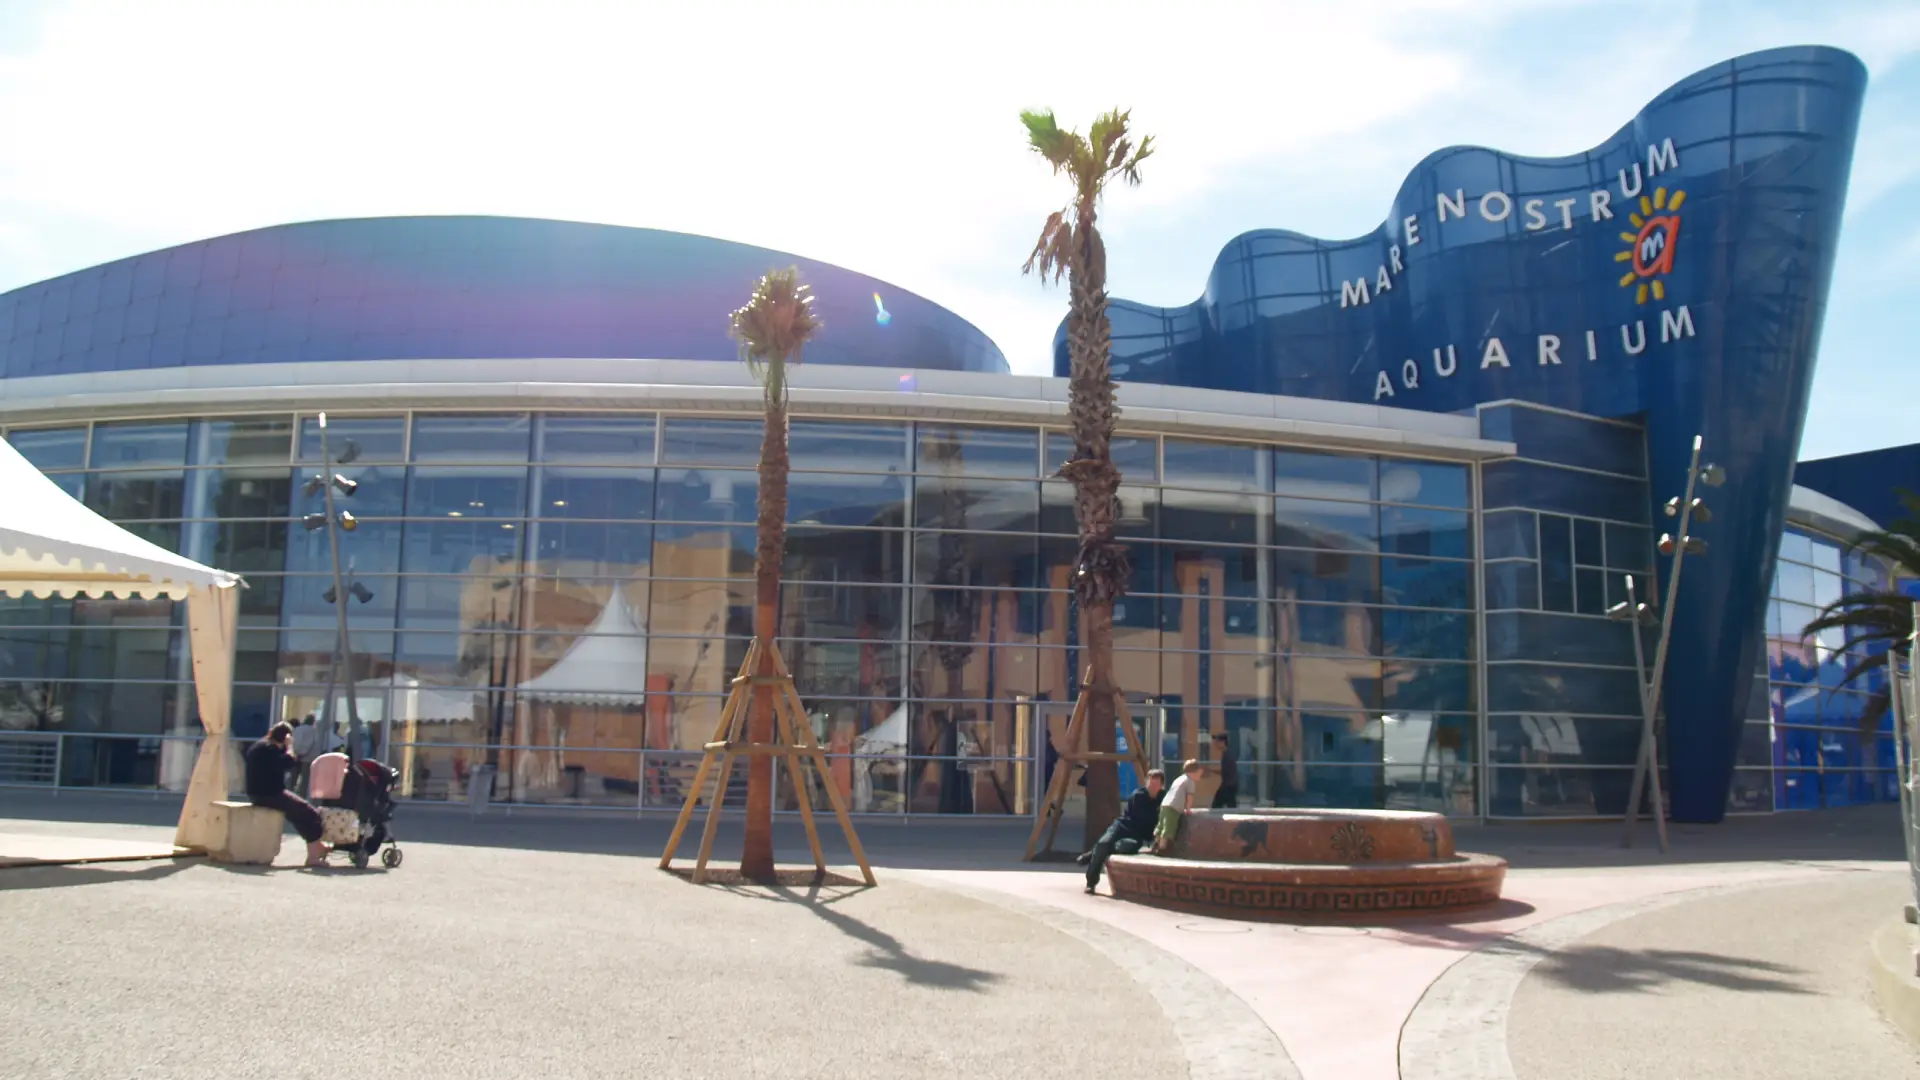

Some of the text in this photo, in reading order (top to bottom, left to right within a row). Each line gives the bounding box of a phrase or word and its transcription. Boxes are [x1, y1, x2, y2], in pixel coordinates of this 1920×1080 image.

[1341, 138, 1678, 308] MARE NOSTRUM
[1374, 305, 1695, 400] AQUARIUM
